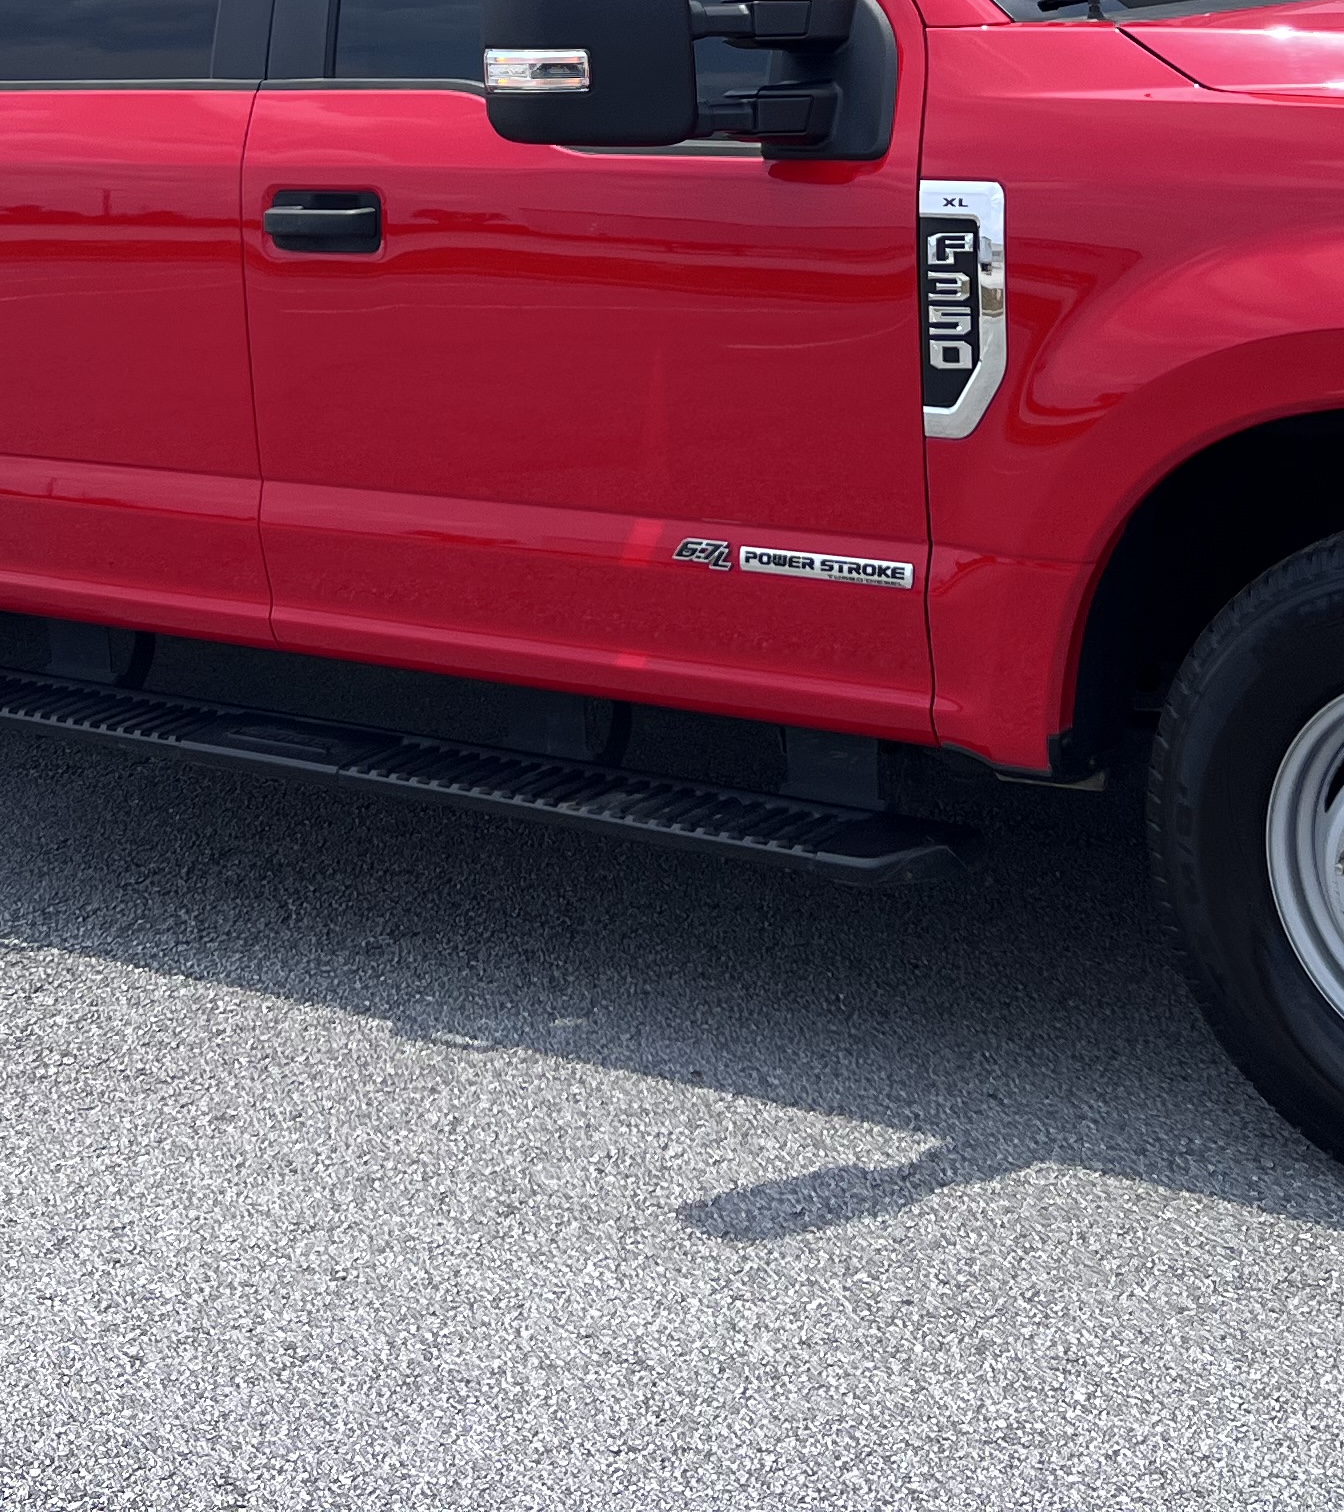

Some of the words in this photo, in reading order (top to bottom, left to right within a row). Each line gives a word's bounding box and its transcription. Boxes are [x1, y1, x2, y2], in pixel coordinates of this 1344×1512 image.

[942, 197, 969, 208] XL
[672, 538, 732, 571] 6.7L
[744, 550, 815, 571] POWER
[820, 558, 906, 581] STROKE
